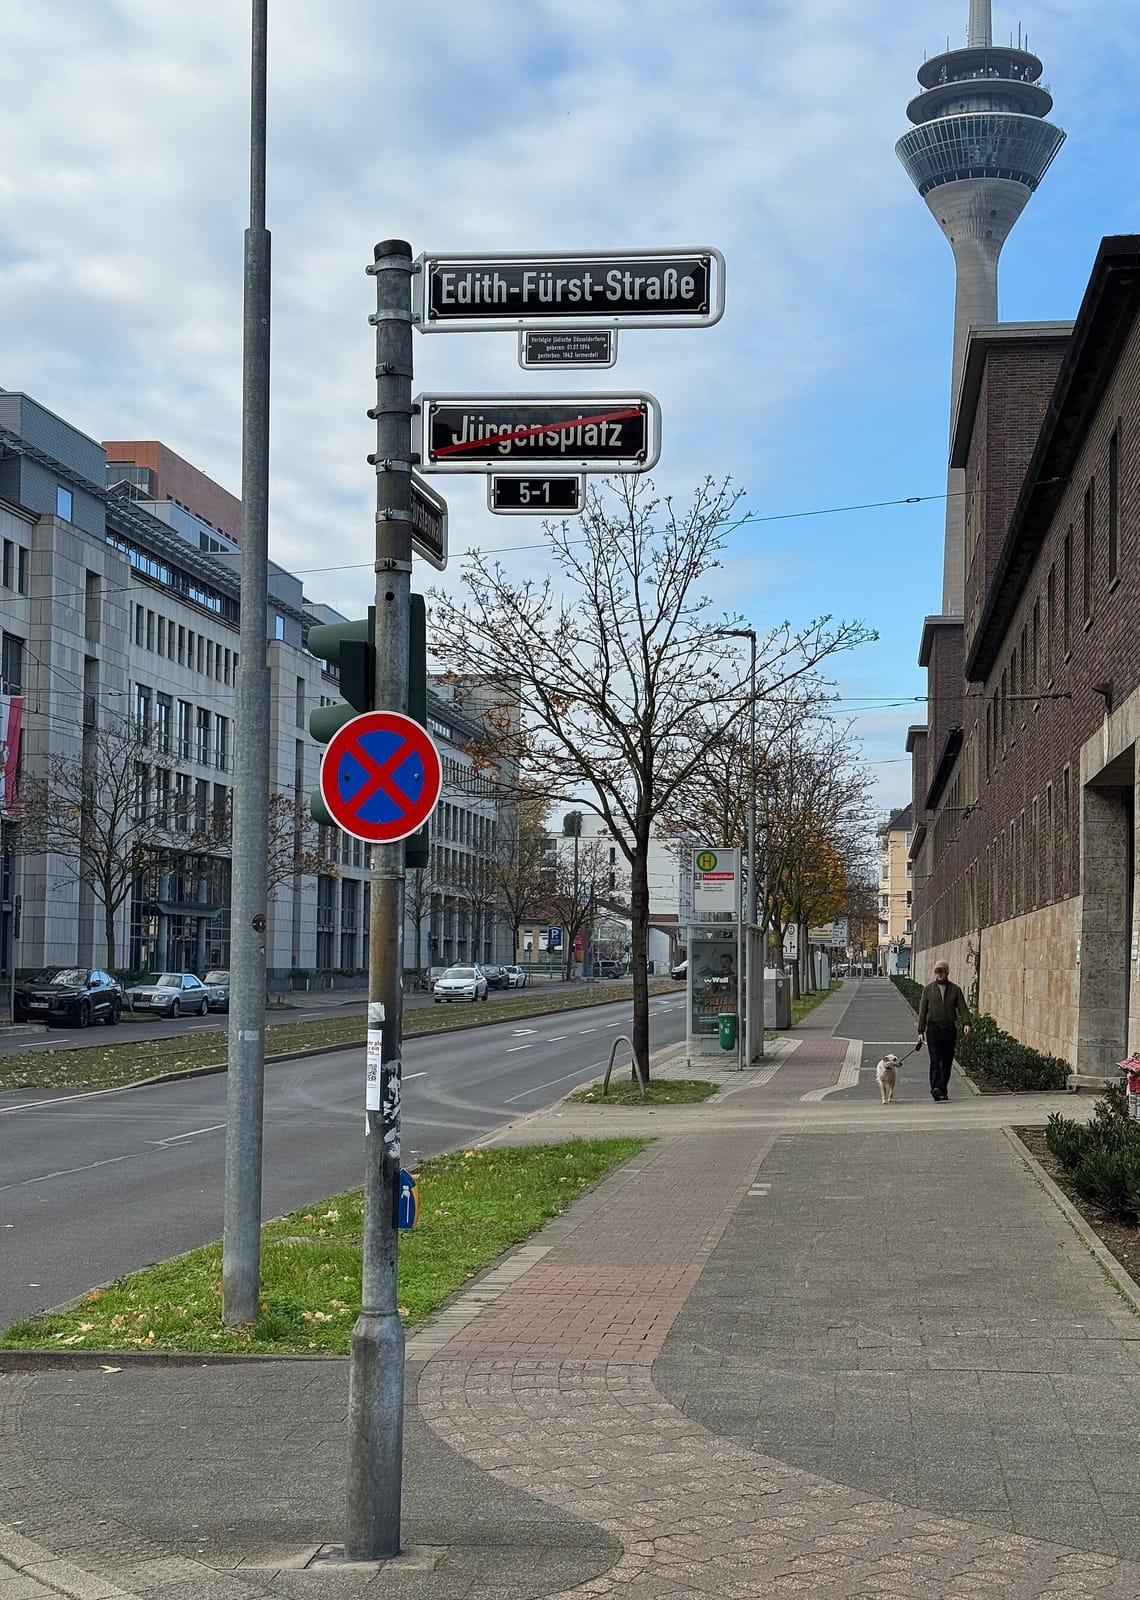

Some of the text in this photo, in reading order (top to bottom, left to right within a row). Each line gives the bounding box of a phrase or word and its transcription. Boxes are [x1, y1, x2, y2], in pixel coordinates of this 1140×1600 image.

[441, 267, 695, 304] Edith-Fürst-Straße
[451, 415, 622, 454] Jürgensplatz
[519, 481, 550, 504] 5-1
